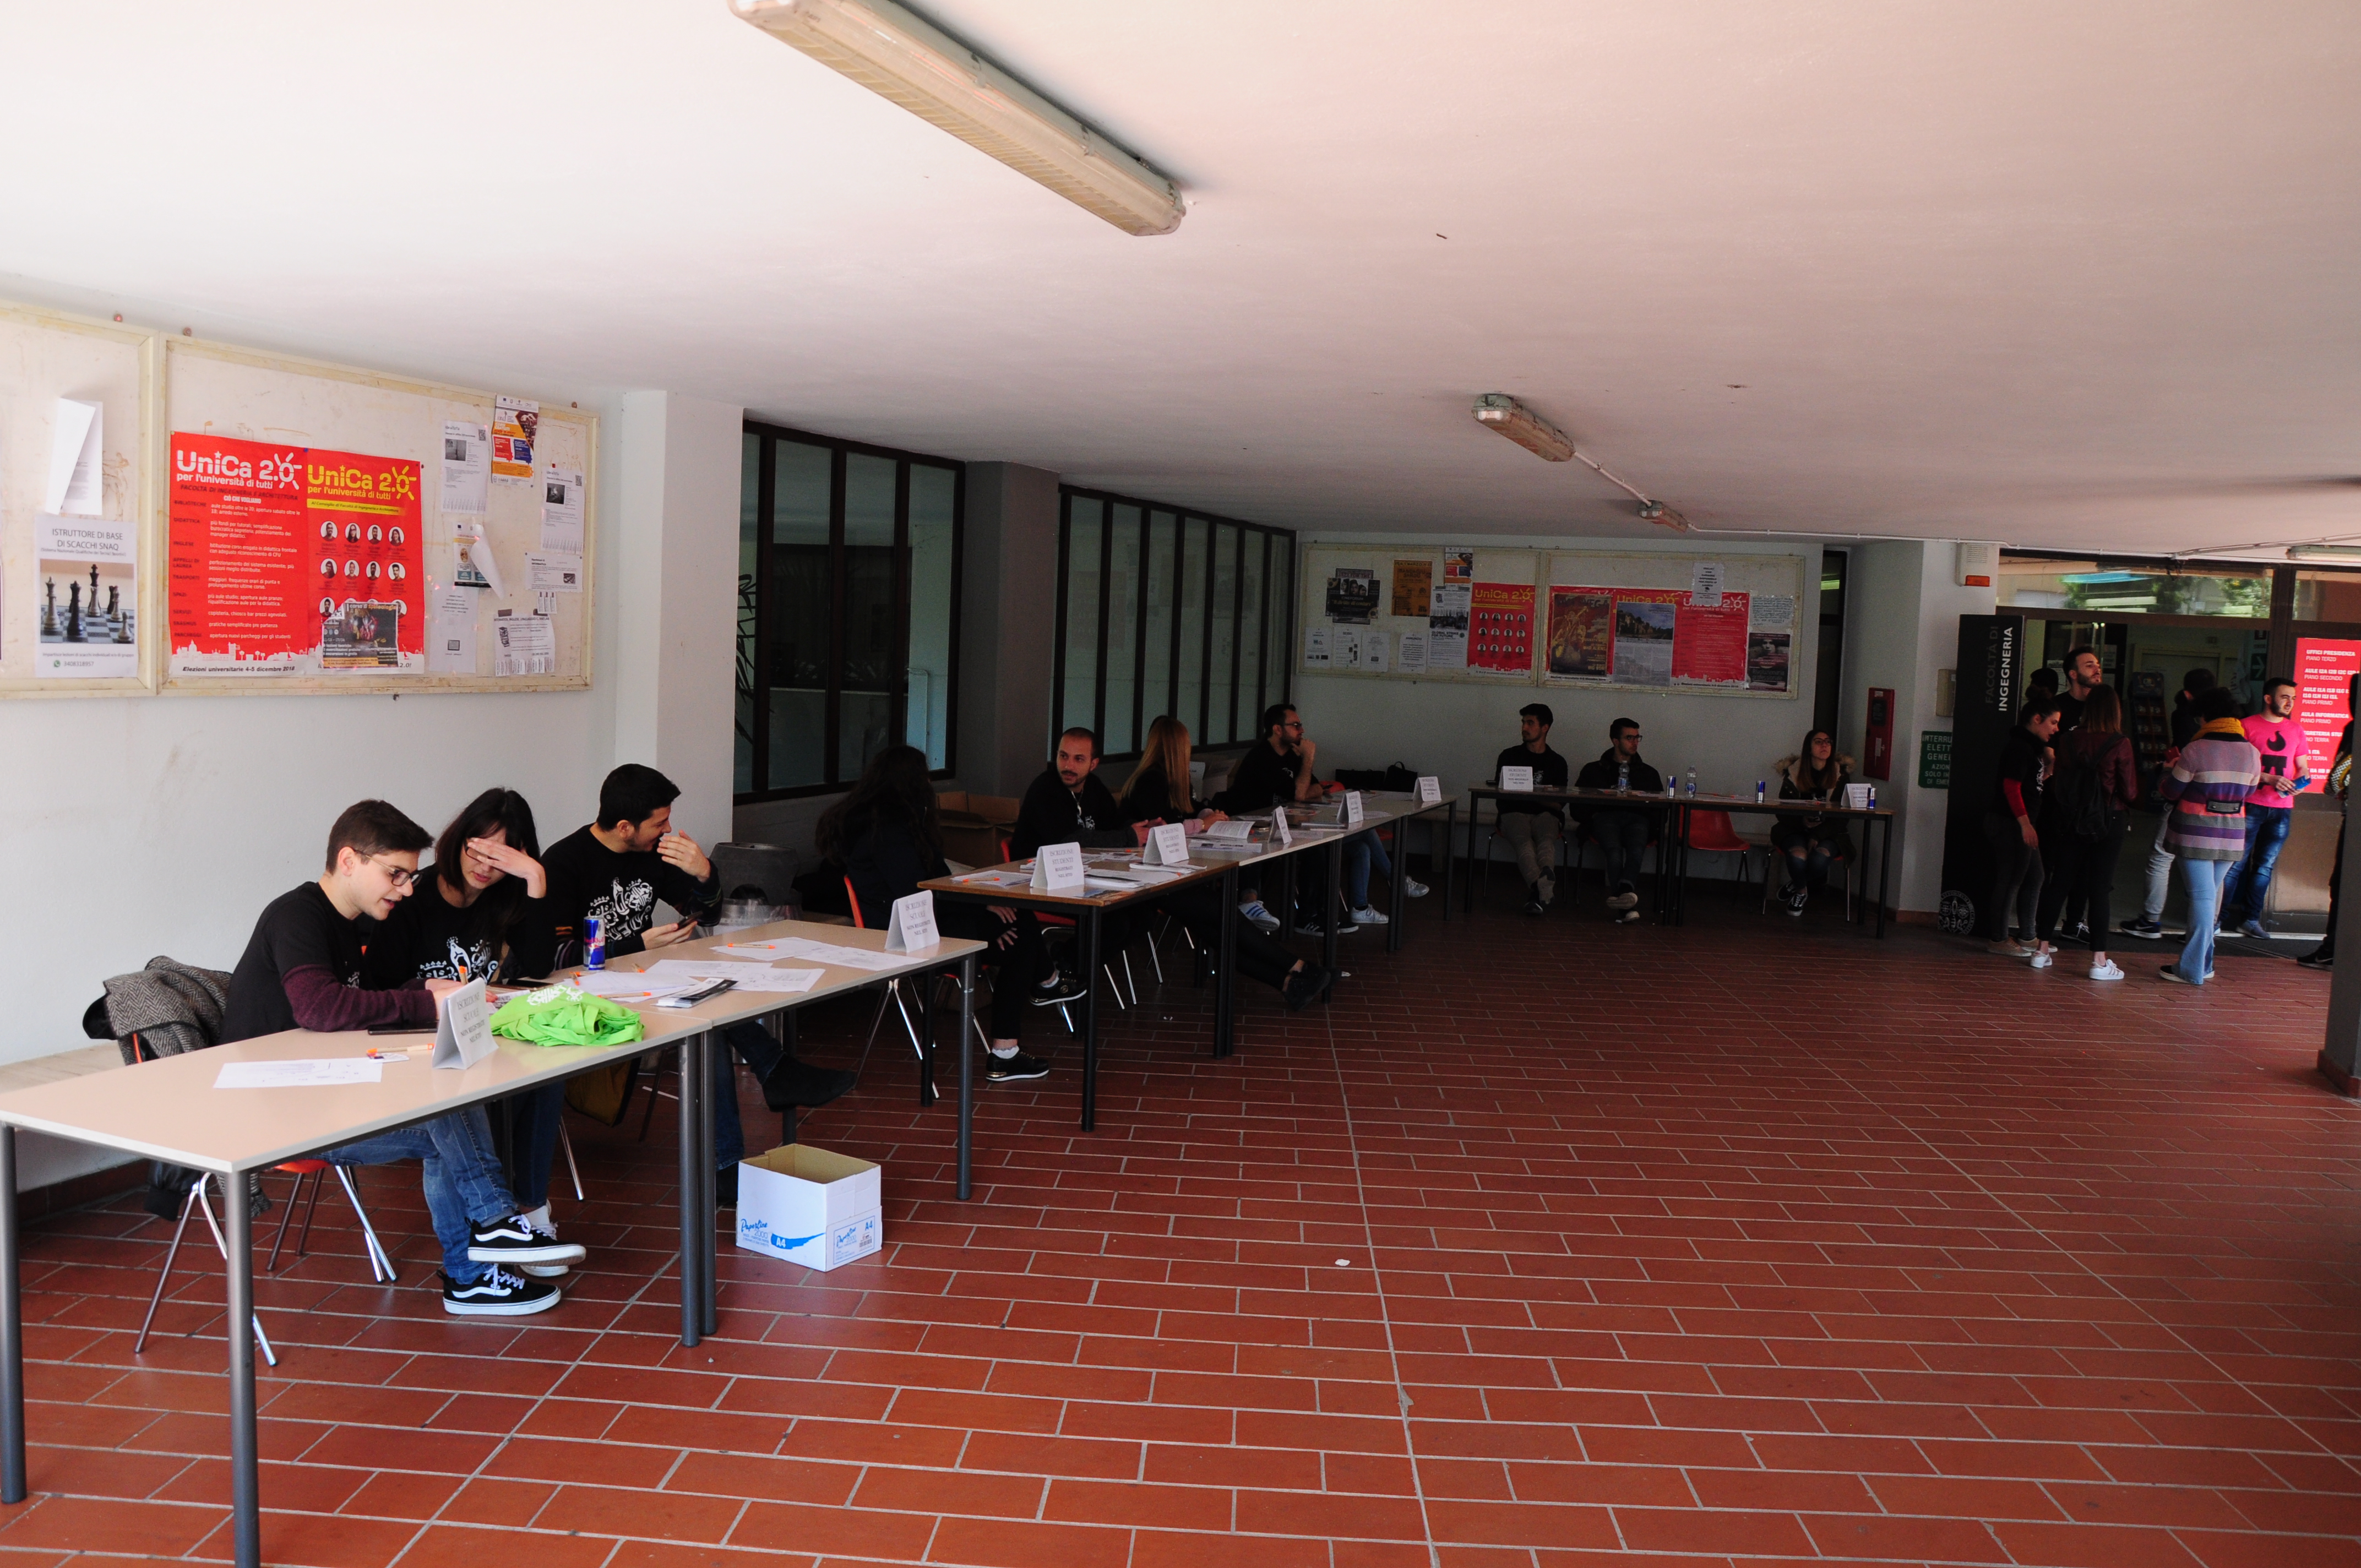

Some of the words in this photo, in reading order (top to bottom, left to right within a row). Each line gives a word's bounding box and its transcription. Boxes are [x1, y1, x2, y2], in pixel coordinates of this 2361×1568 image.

[177, 450, 252, 478] UniCa
[259, 457, 299, 484] 2.0
[177, 473, 193, 482] per
[196, 474, 244, 486] l'università
[246, 478, 254, 487] di
[256, 480, 273, 489] tutti
[308, 464, 373, 489] UniCa
[379, 470, 414, 496] 2.0
[324, 487, 366, 497] l'università
[376, 492, 391, 500] tutti
[52, 529, 95, 538] ISTRUTTORE
[67, 541, 97, 549] SCACCHI
[1475, 589, 1508, 600] UniCa
[1989, 626, 1999, 640] DI
[1985, 643, 1998, 704] FACOLTÀ
[1998, 627, 2013, 711] INGEGNERIA
[457, 992, 480, 1010] ISCRIZIONE
[464, 1008, 479, 1022] SCUOLE
[865, 1221, 873, 1231] A4
[754, 1229, 768, 1239] 2000
[776, 1237, 786, 1248] A4
